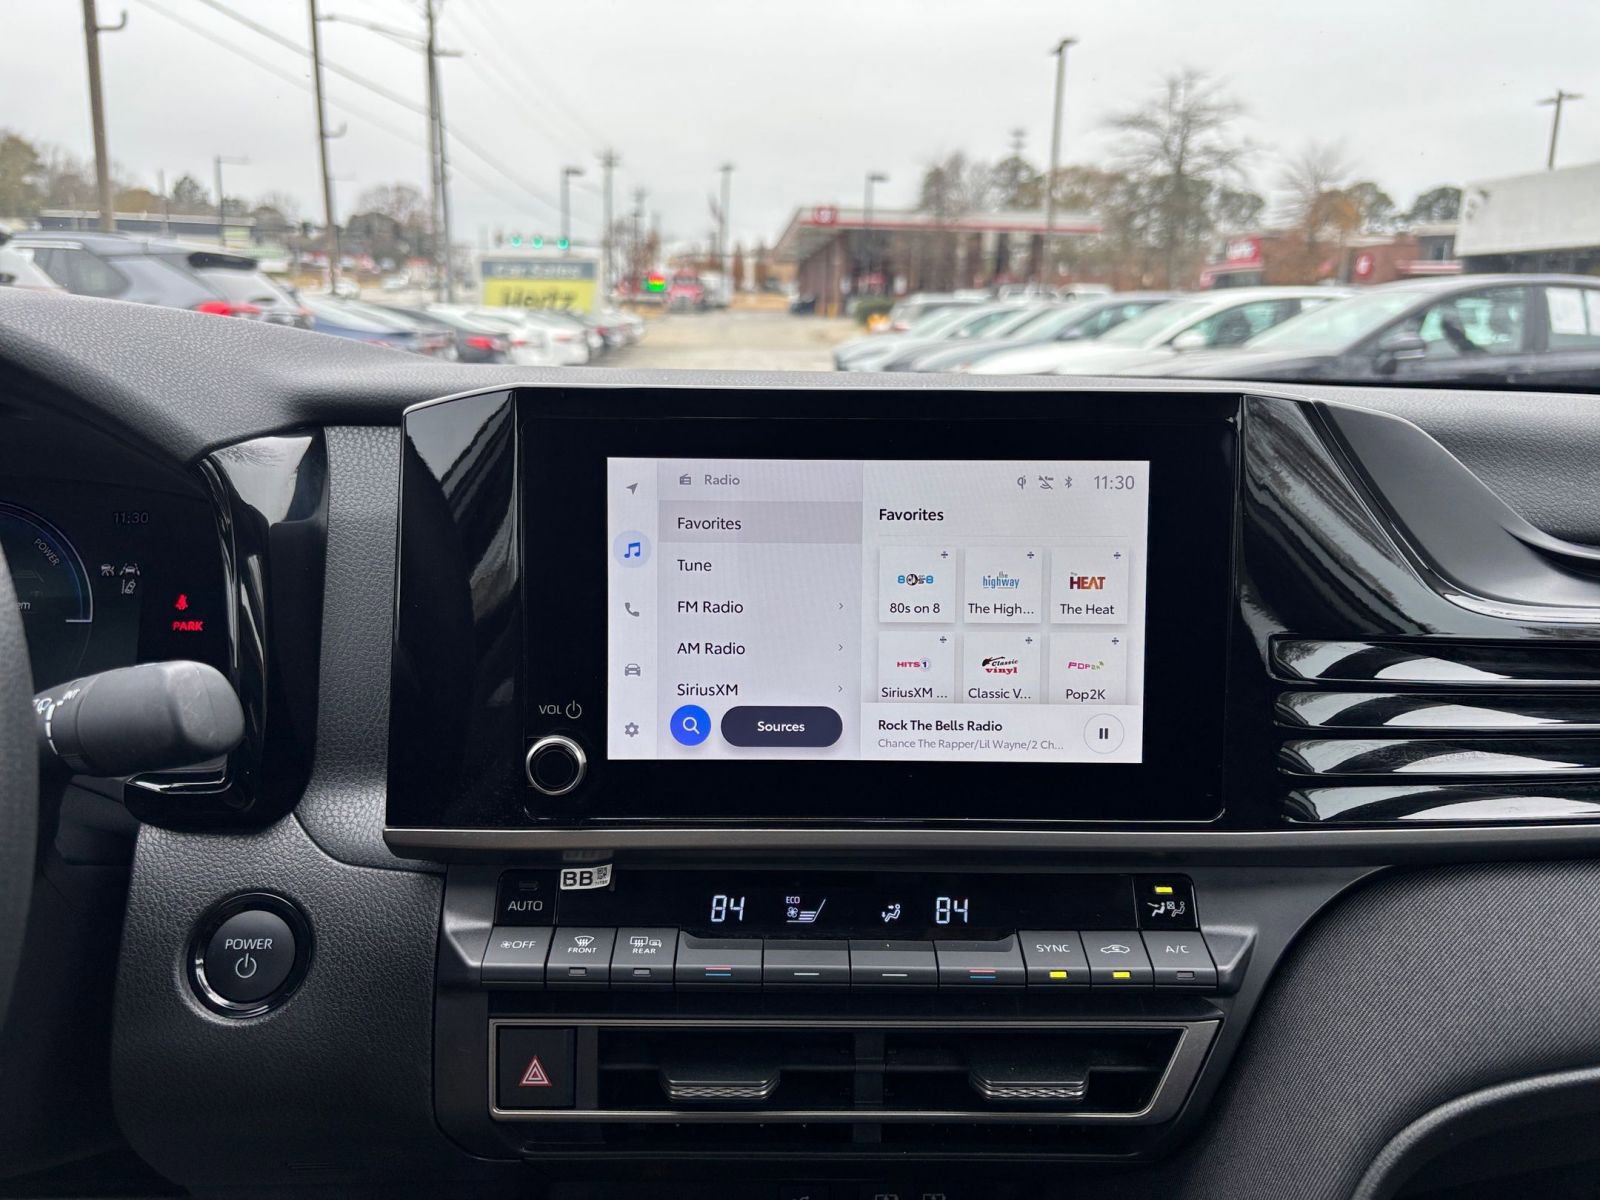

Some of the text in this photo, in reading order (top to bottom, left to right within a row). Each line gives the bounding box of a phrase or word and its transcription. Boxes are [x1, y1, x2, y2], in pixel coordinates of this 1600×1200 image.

[704, 474, 740, 486] Radio
[1094, 475, 1135, 490] 11:30
[113, 512, 149, 524] 11:30
[879, 508, 944, 521] Favorites
[677, 517, 742, 530] Favorites
[34, 538, 60, 567] POWER
[677, 559, 712, 572] Tune
[983, 576, 1019, 589] highway
[1070, 576, 1105, 589] HEAT
[677, 600, 744, 613] FM Radio
[889, 603, 941, 614] 80s on 8
[968, 603, 990, 614] The
[1060, 603, 1115, 615] The Heat
[172, 620, 203, 631] PARK
[677, 642, 746, 655] AM Radio
[985, 667, 1018, 675] vinyl
[677, 683, 739, 697] SiriusXM
[881, 687, 933, 699] SiriusXM
[968, 688, 1010, 700] Classic
[1066, 689, 1106, 702] Pop2K
[539, 704, 562, 715] VOL
[757, 720, 805, 732] Sources
[878, 720, 1003, 732] Rock The Bells Radio
[878, 739, 916, 749] Chance
[918, 739, 937, 749] The
[938, 739, 991, 752] Rapper/Lil
[993, 740, 1038, 752] Wayne/2
[563, 871, 594, 887] BB
[507, 900, 543, 912] AUTO
[785, 896, 800, 904] ECO
[710, 895, 746, 922] 84
[936, 896, 969, 924] 84
[225, 938, 273, 950] POWER
[512, 940, 536, 949] OFF
[1036, 944, 1070, 953] SYNC
[1165, 944, 1189, 954] A/C
